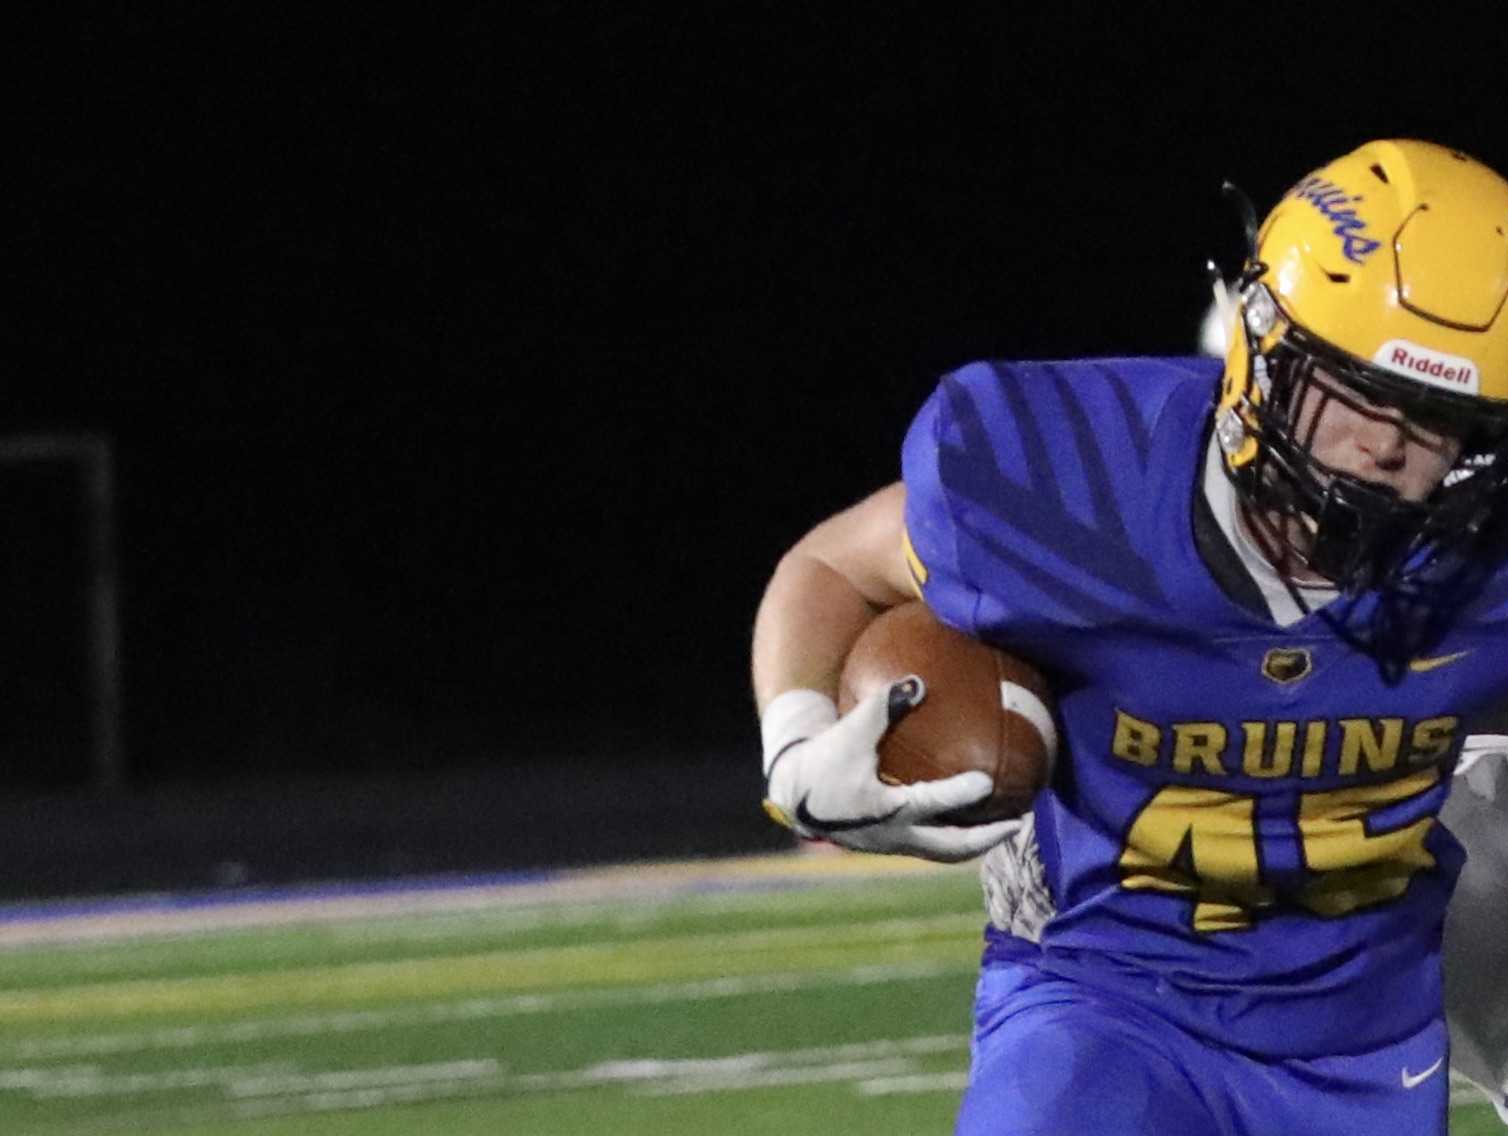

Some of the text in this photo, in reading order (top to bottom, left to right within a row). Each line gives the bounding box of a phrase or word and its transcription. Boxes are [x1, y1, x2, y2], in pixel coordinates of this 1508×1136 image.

[1391, 347, 1472, 385] Riddell
[1111, 708, 1460, 779] BRUINS
[1118, 768, 1444, 934] 45
